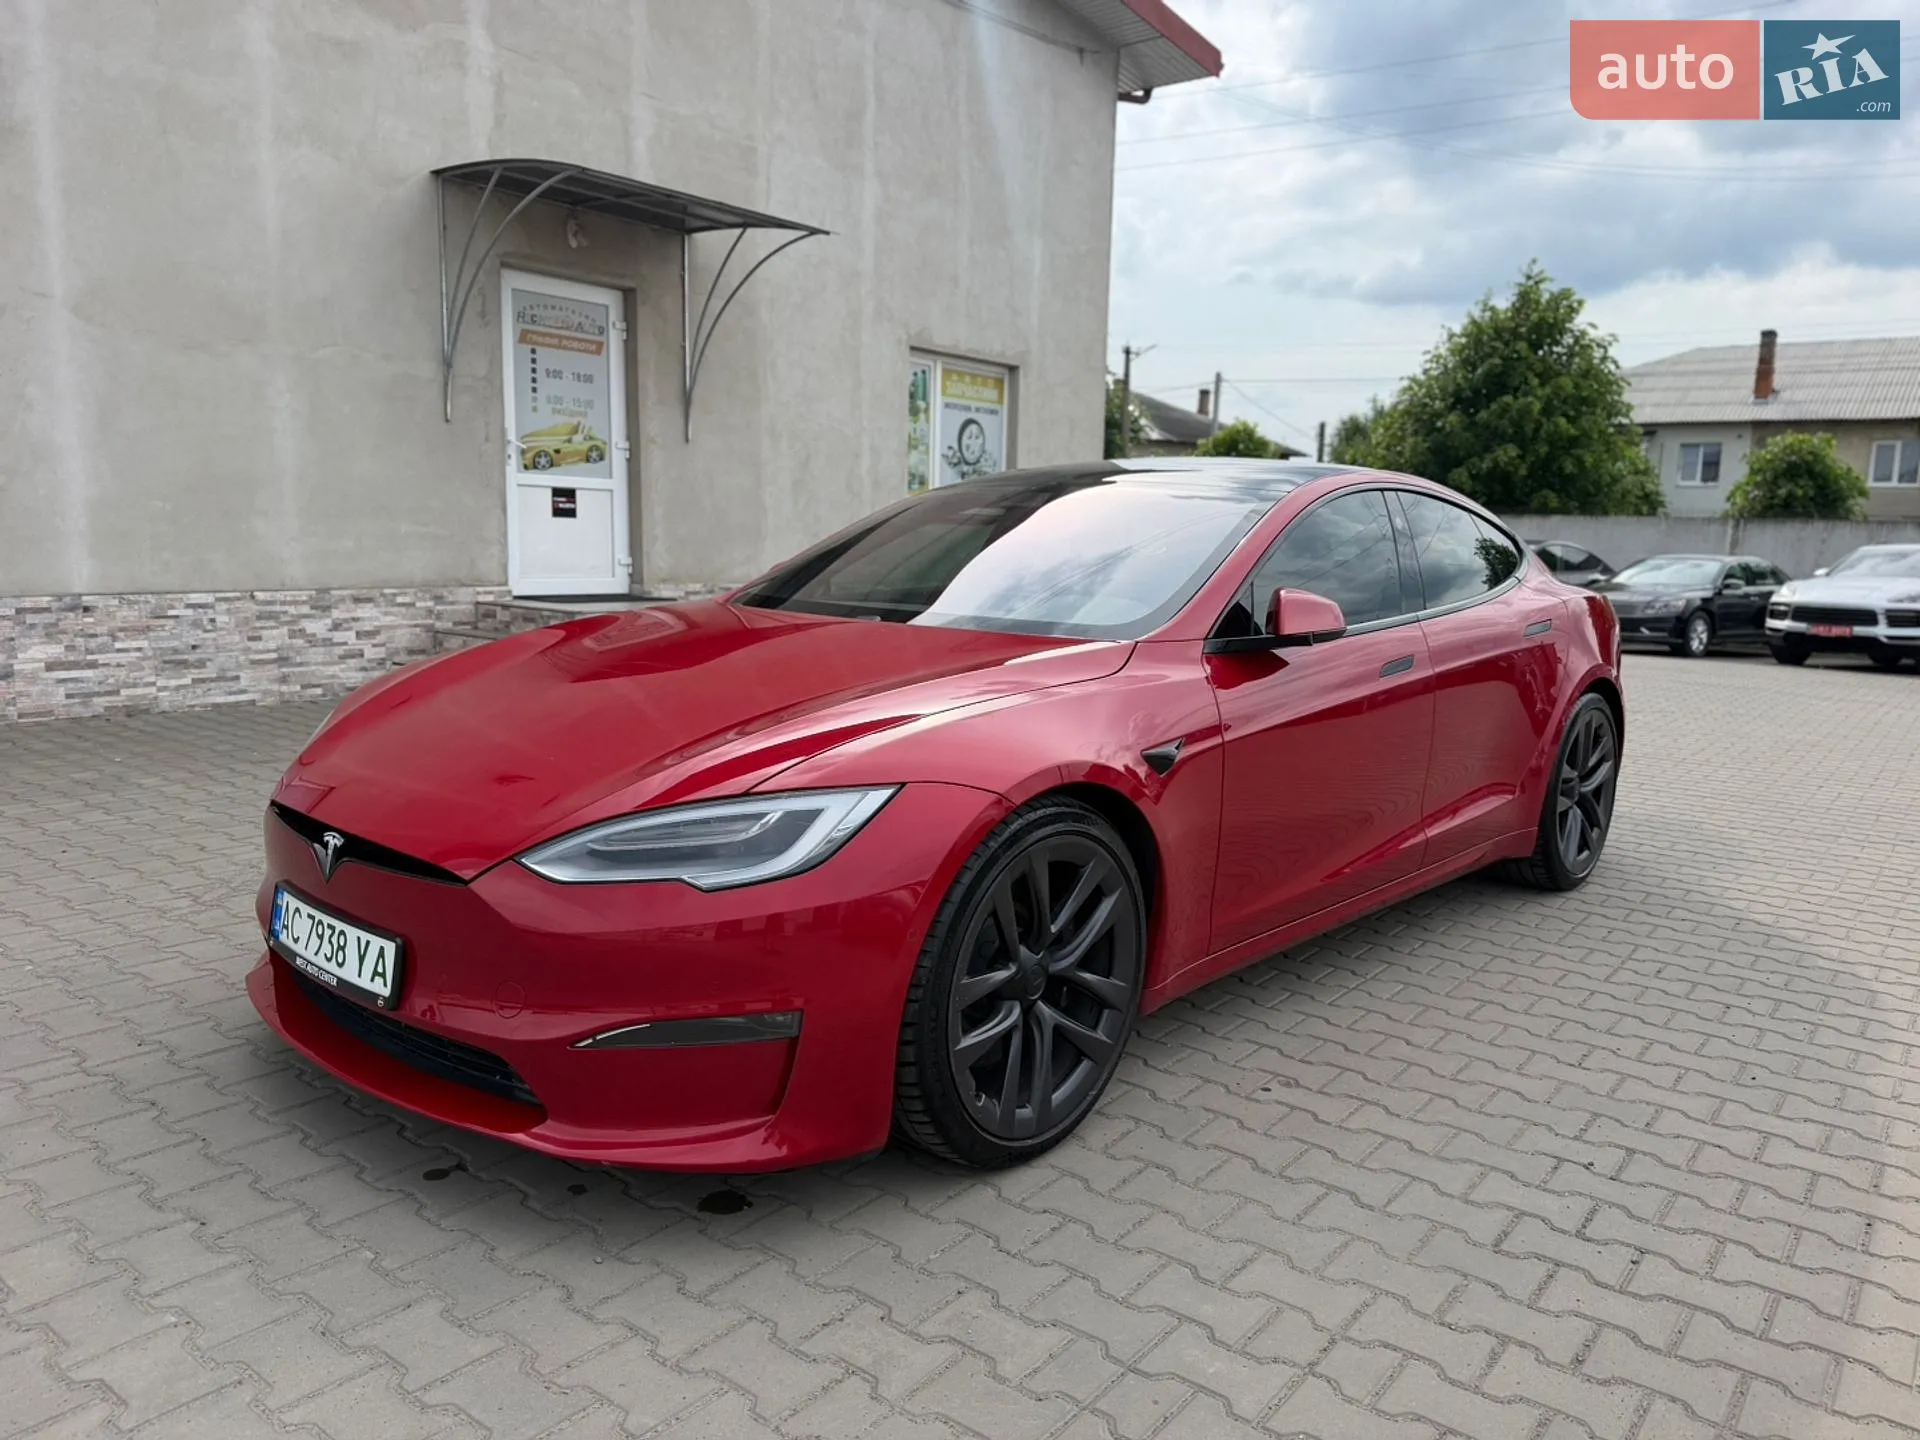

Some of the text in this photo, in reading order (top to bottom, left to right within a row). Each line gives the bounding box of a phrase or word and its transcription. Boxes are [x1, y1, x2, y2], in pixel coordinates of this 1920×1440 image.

[281, 900, 388, 988] AC 7938 YA
